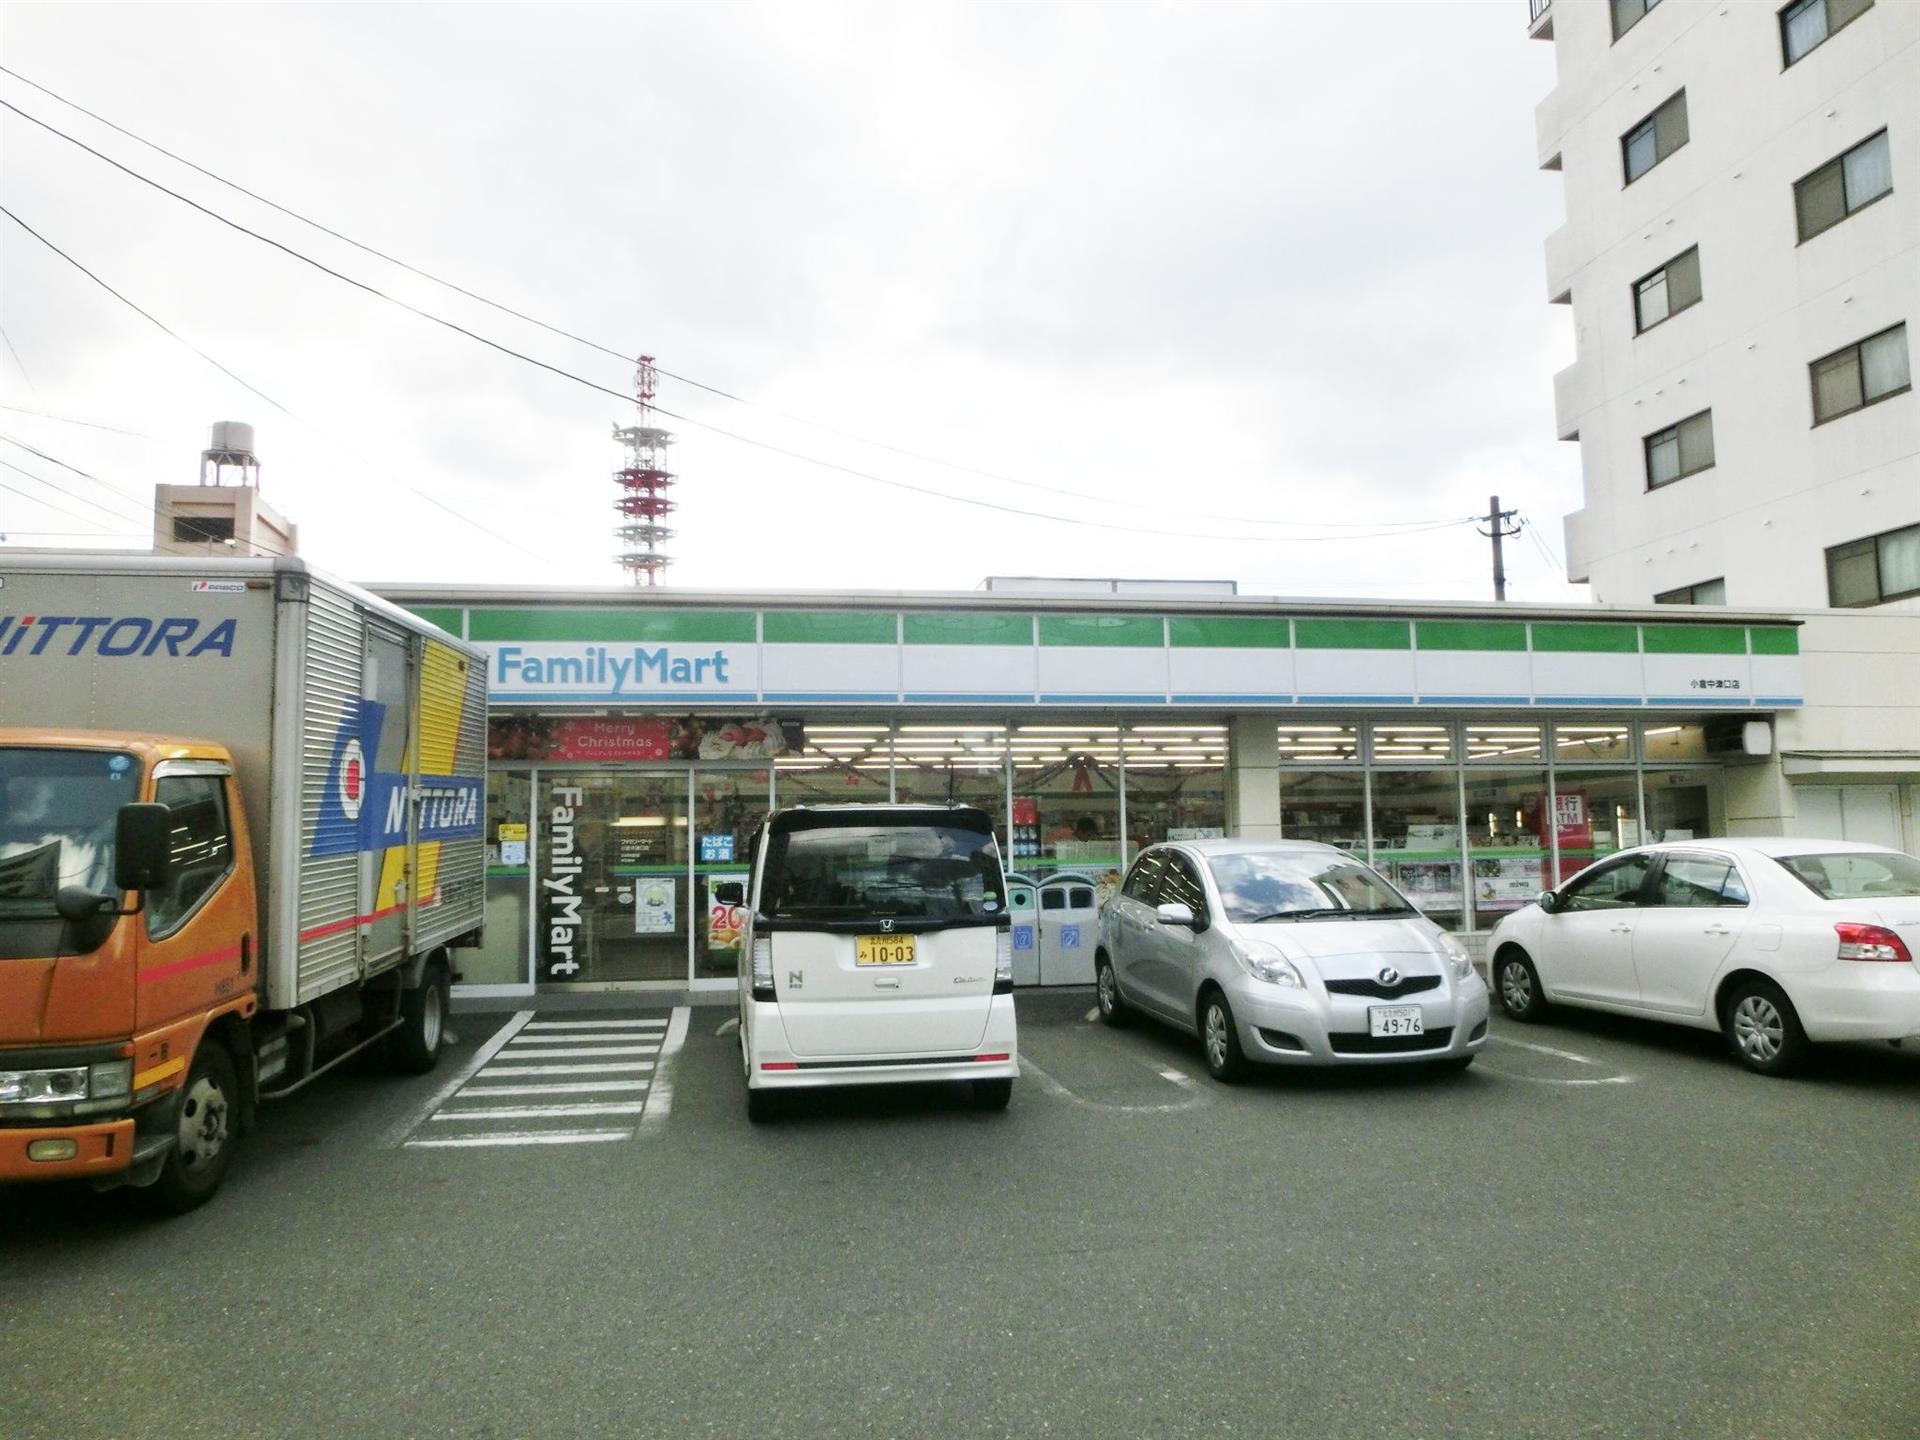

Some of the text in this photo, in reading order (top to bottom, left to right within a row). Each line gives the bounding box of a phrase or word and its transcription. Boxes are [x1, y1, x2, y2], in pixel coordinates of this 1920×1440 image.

[498, 647, 729, 694] FamilyMart
[594, 721, 636, 738] Merry
[577, 736, 652, 747] Christmas
[384, 786, 477, 834] NTTORA
[702, 836, 733, 847] たばこ
[543, 787, 582, 975] FamilyMart
[872, 946, 914, 962] 10-03
[789, 970, 803, 983] N
[1383, 1018, 1421, 1034] 49-76
